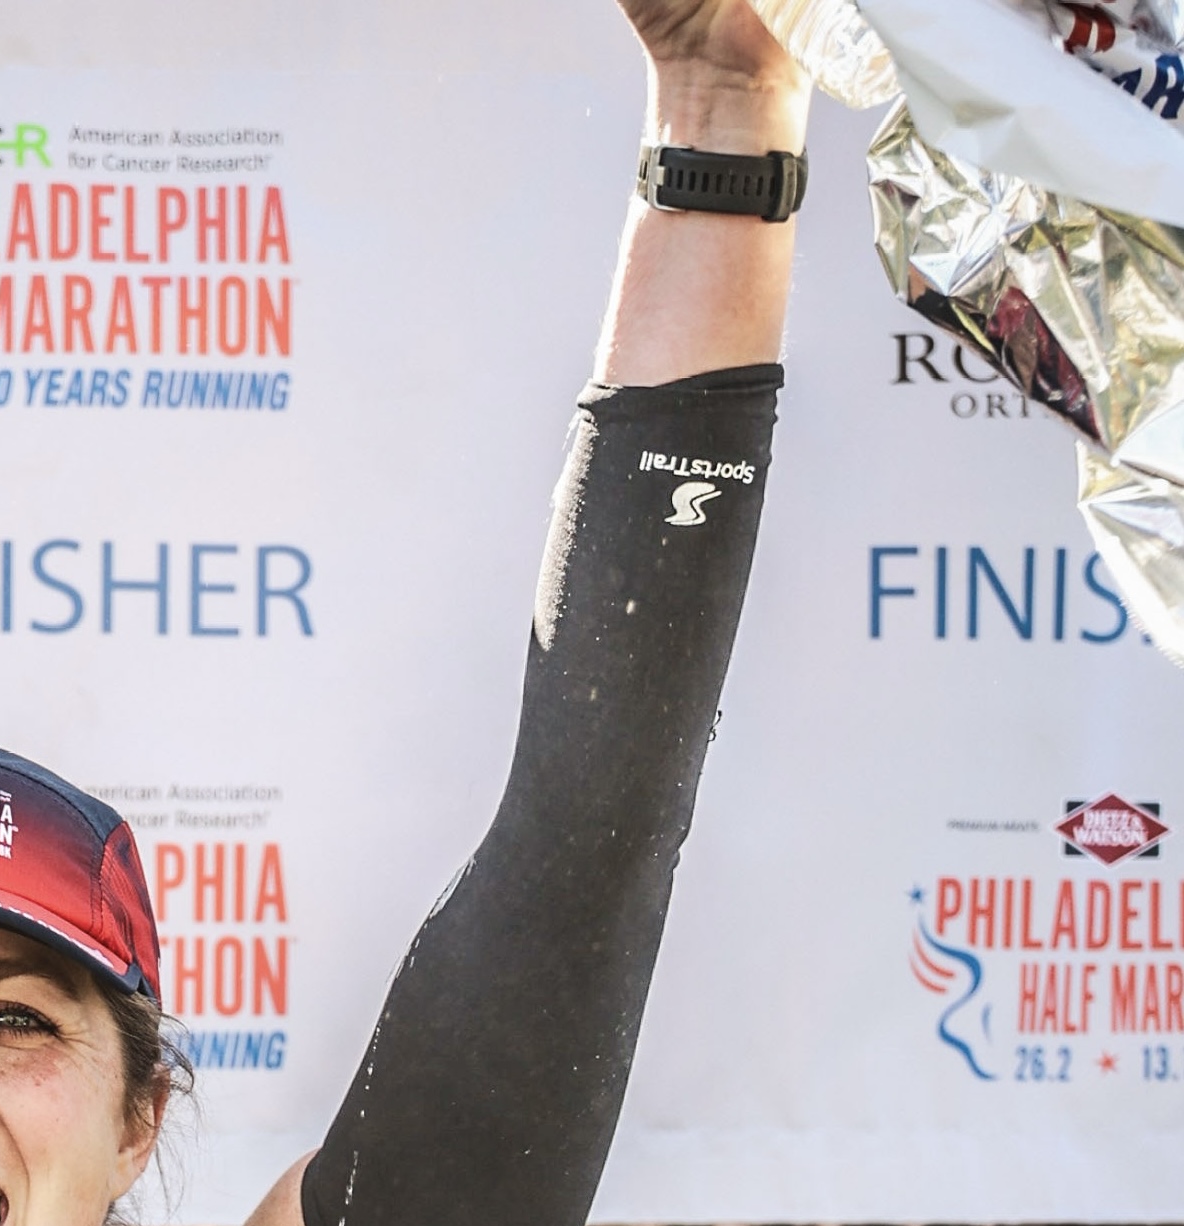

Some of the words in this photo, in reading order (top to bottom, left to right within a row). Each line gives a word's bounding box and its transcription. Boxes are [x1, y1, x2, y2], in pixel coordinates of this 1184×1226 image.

[69, 127, 162, 146] American
[169, 129, 283, 146] Association
[67, 152, 96, 170] for
[101, 153, 169, 172] Cancer
[24, 369, 131, 408] YEARS
[140, 369, 292, 411] RUNNING
[639, 450, 756, 484] SportsTrail
[870, 547, 1153, 644] FINIS
[167, 784, 284, 801] Association
[154, 842, 287, 924] PHIA
[935, 876, 1184, 949] PHILADEL
[1017, 963, 1097, 1035] HALF
[1015, 1045, 1072, 1082] 26.2
